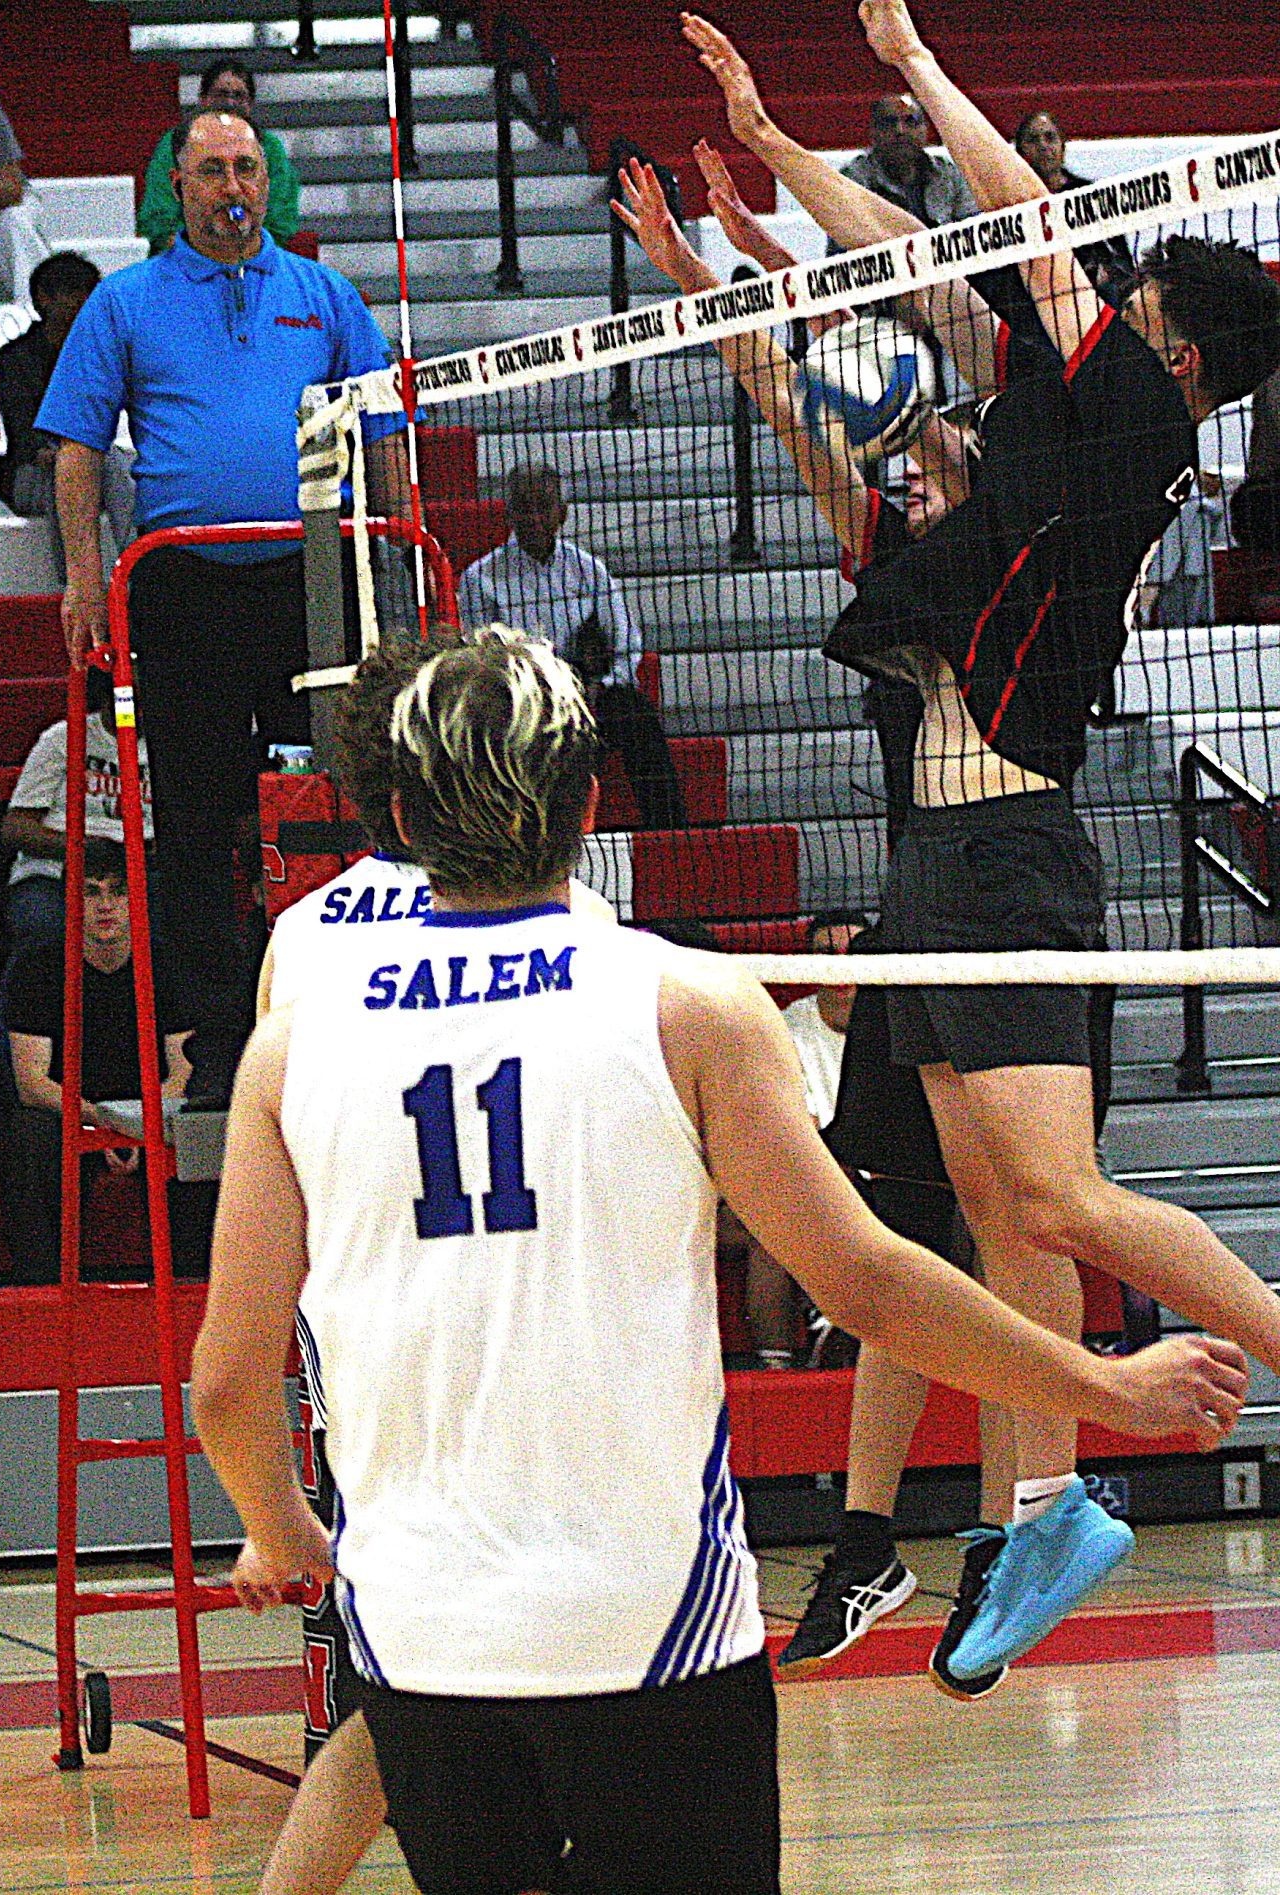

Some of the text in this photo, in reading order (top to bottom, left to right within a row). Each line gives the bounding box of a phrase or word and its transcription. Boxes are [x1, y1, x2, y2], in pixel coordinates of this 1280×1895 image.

[320, 884, 433, 924] SALE
[363, 946, 577, 1011] SALEM
[402, 1056, 538, 1240] 11
